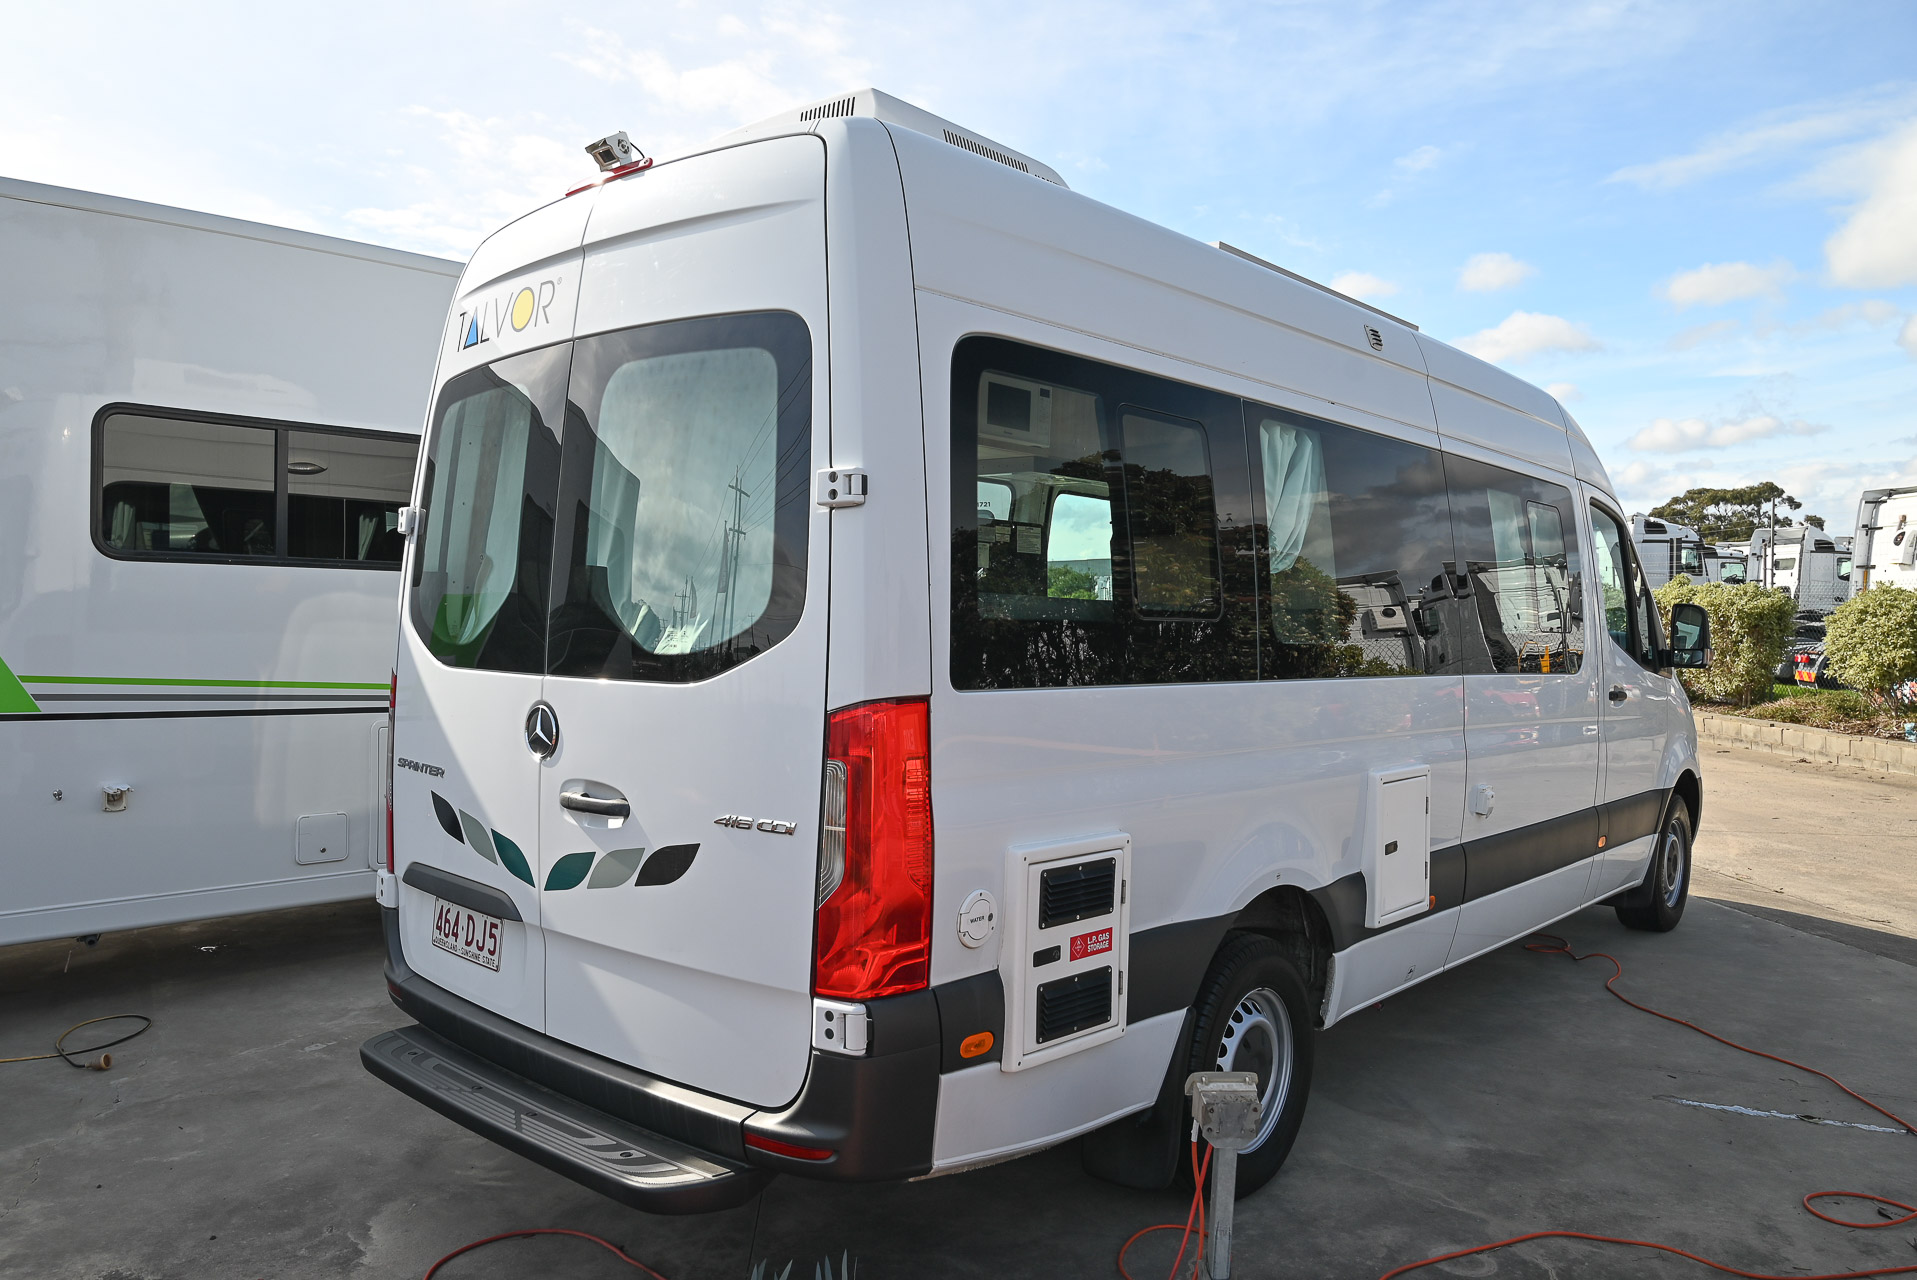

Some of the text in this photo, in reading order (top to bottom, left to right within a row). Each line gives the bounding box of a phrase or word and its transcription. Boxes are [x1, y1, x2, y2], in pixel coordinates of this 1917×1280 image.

[457, 279, 556, 353] TALVOR
[397, 757, 446, 778] SPRINTER
[713, 814, 798, 836] 416 CDI
[970, 915, 985, 924] WATER
[1087, 932, 1110, 945] L.P. GAS
[1087, 940, 1110, 952] STORAGE
[434, 936, 458, 952] QUEENSLAND
[461, 947, 481, 962] SUNSHINE
[482, 955, 496, 968] STATE
